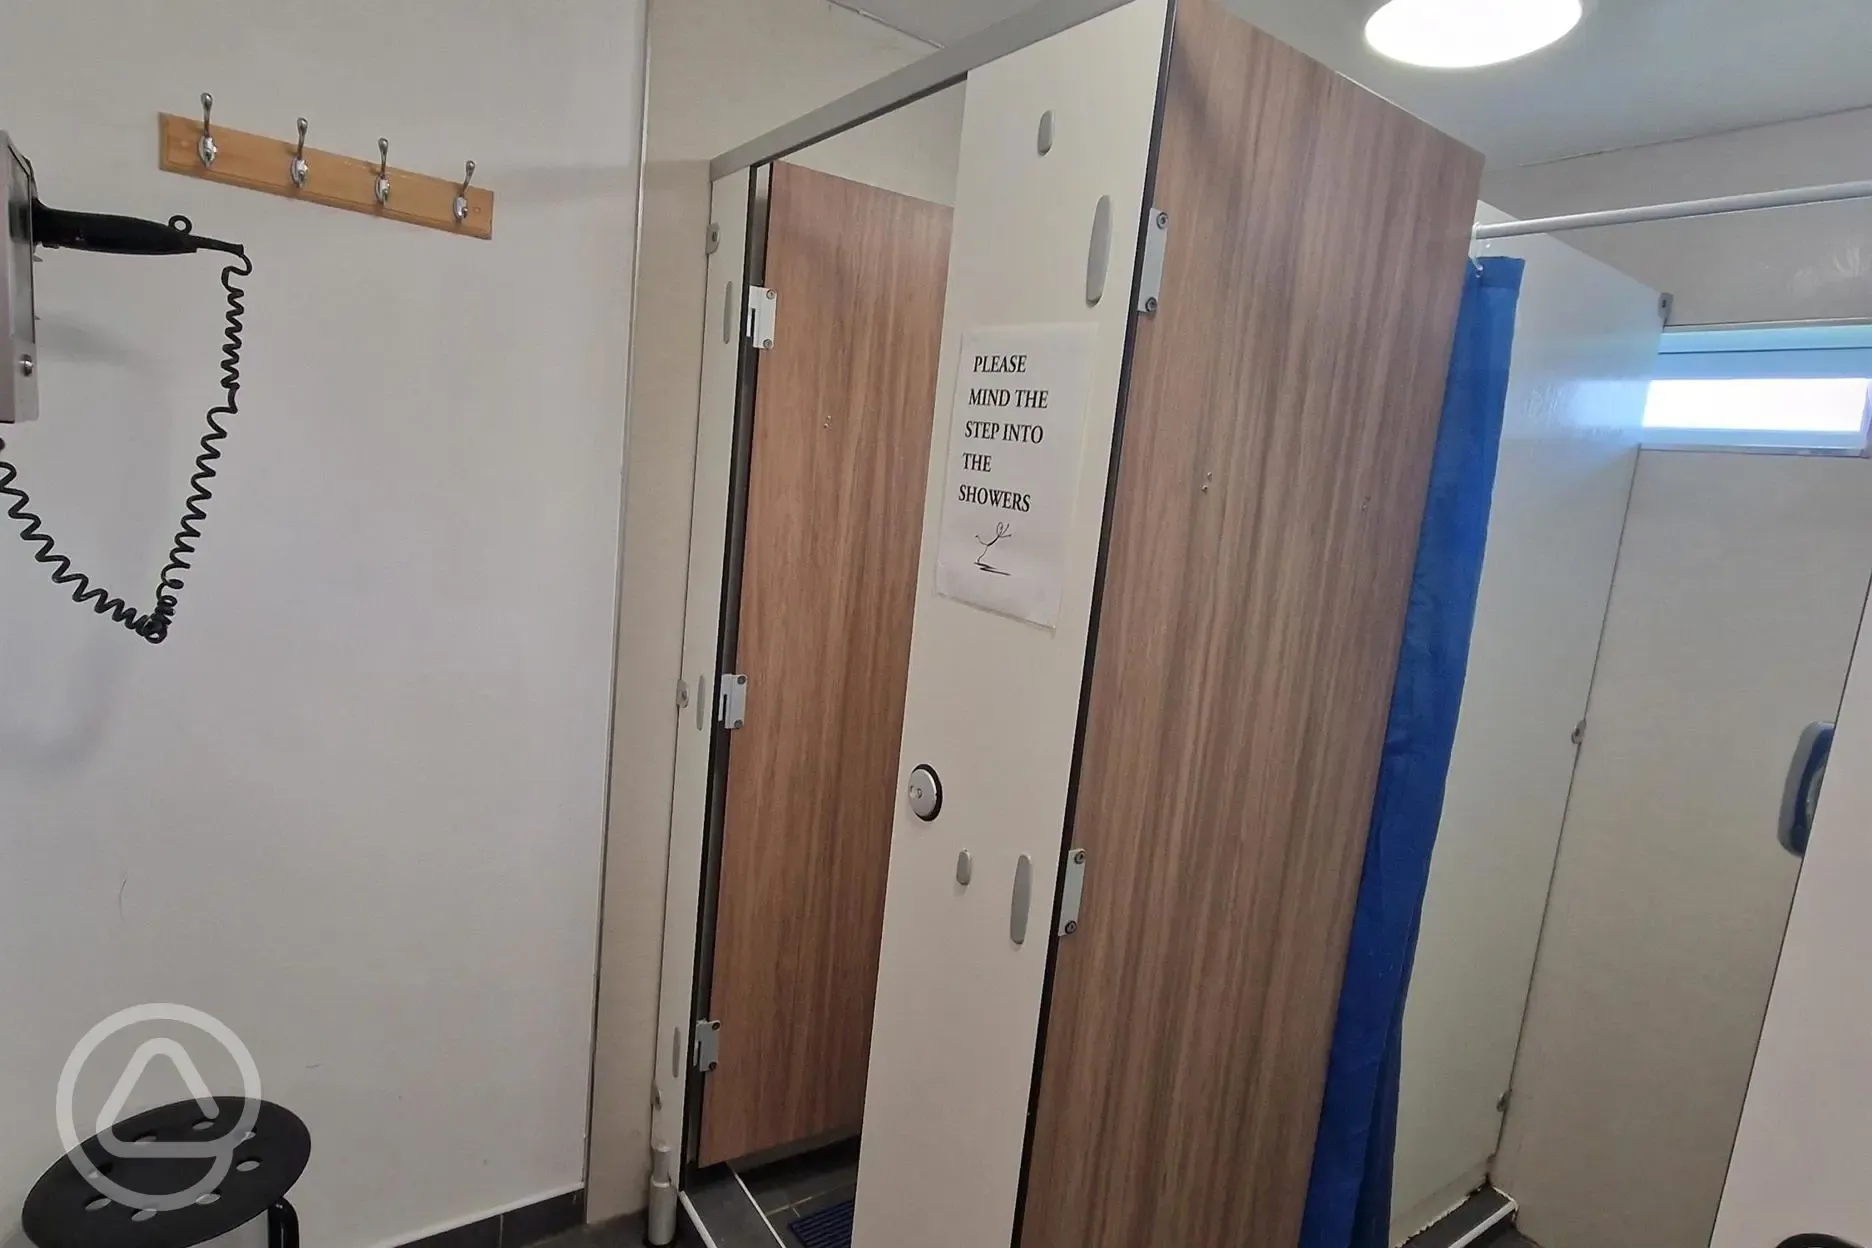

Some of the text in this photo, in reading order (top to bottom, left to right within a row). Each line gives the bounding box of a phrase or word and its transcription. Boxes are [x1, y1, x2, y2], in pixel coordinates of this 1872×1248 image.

[973, 355, 1027, 373] PLEASE
[968, 388, 1049, 409] MIND THE
[965, 421, 1044, 444] STEP INTO
[962, 452, 992, 472] THE
[958, 485, 1031, 512] SHOWERS
